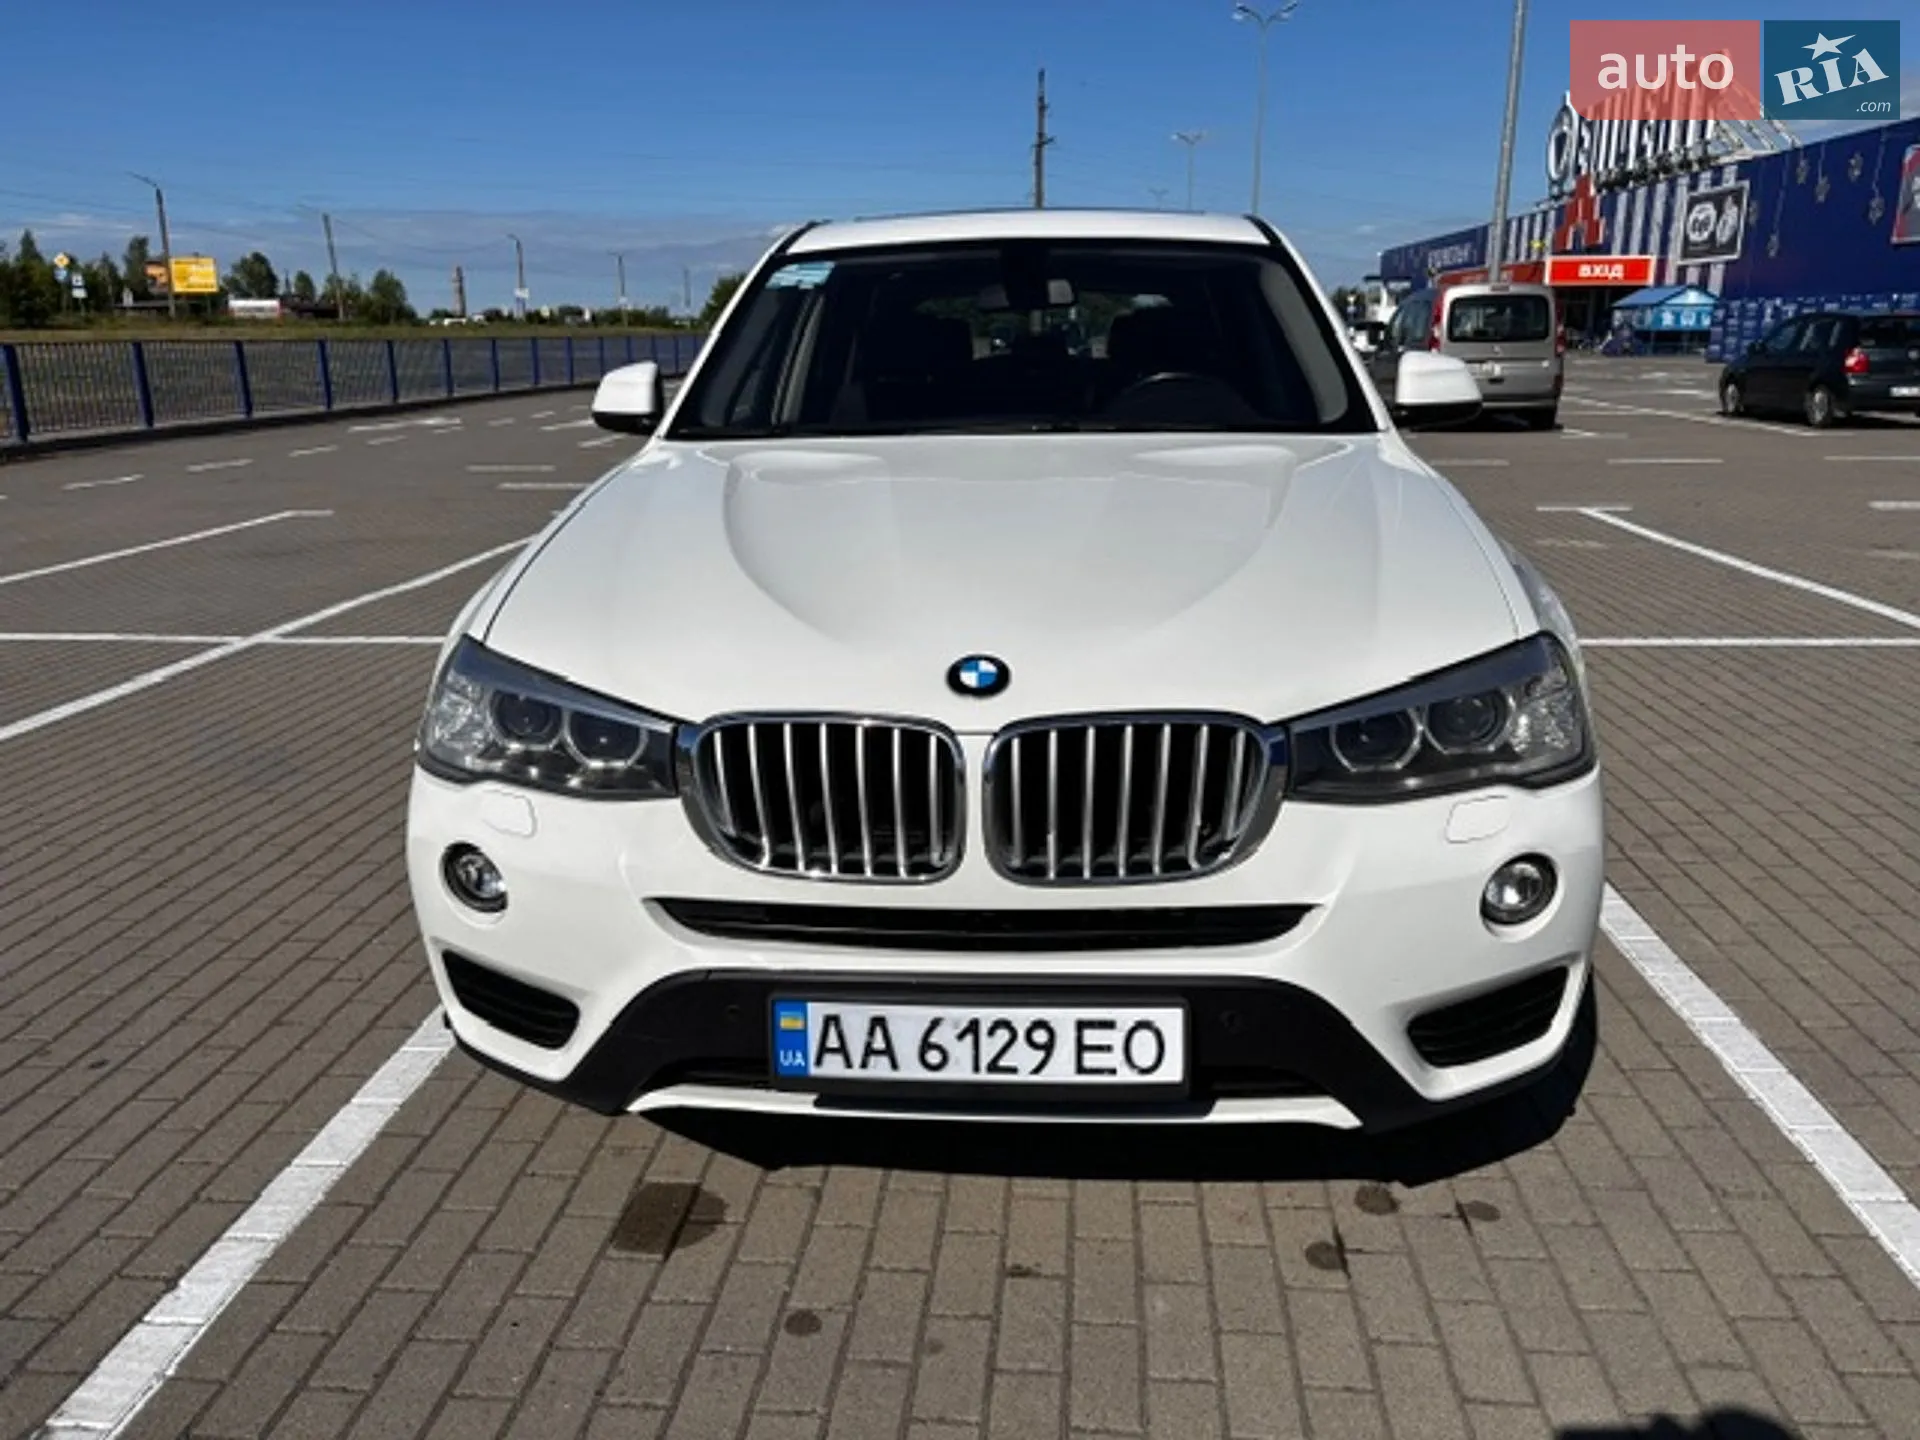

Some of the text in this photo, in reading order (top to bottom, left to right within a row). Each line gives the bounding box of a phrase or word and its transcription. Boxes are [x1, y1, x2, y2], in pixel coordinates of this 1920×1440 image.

[780, 1051, 806, 1068] UA
[813, 1014, 1167, 1077] AA 6129 EO
